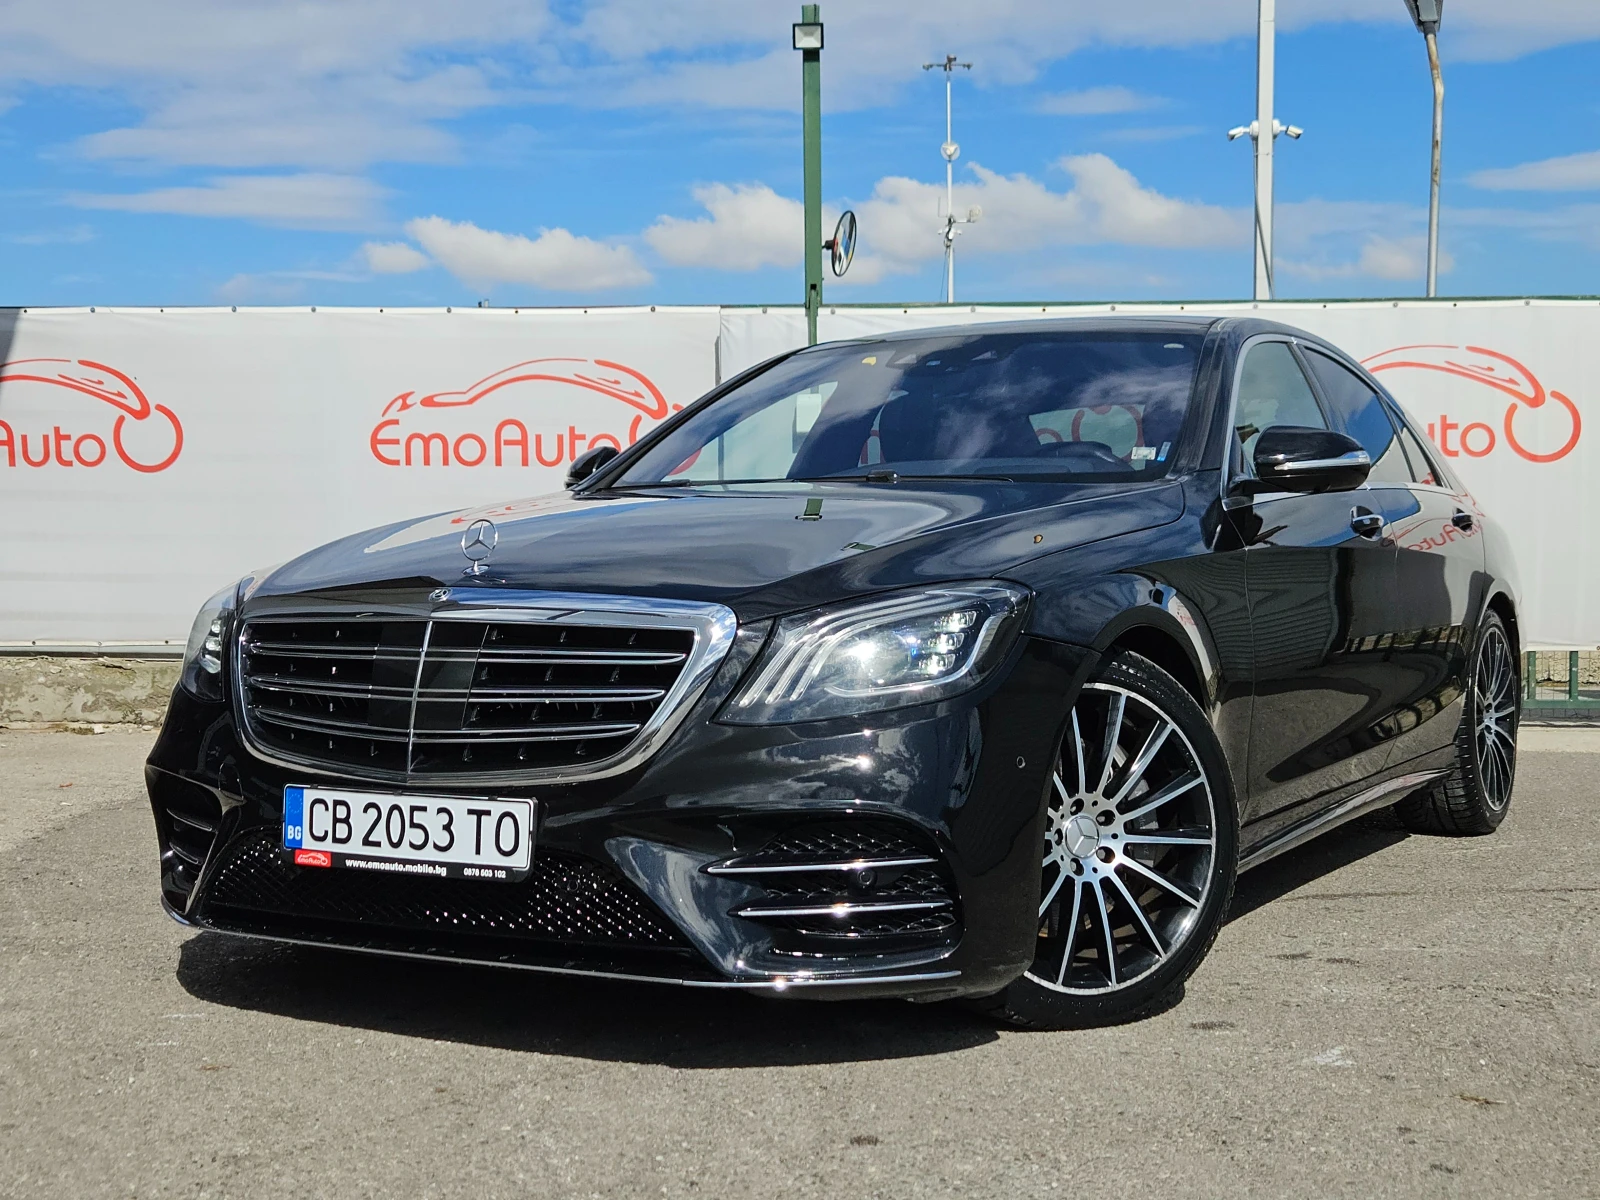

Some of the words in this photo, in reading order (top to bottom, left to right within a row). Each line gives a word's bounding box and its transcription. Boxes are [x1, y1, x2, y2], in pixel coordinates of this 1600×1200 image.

[287, 824, 302, 841] BG
[309, 797, 352, 844] CB
[362, 802, 455, 852] 2053
[467, 808, 520, 857] TO
[345, 858, 447, 876] www.emoauto.mobile.bg
